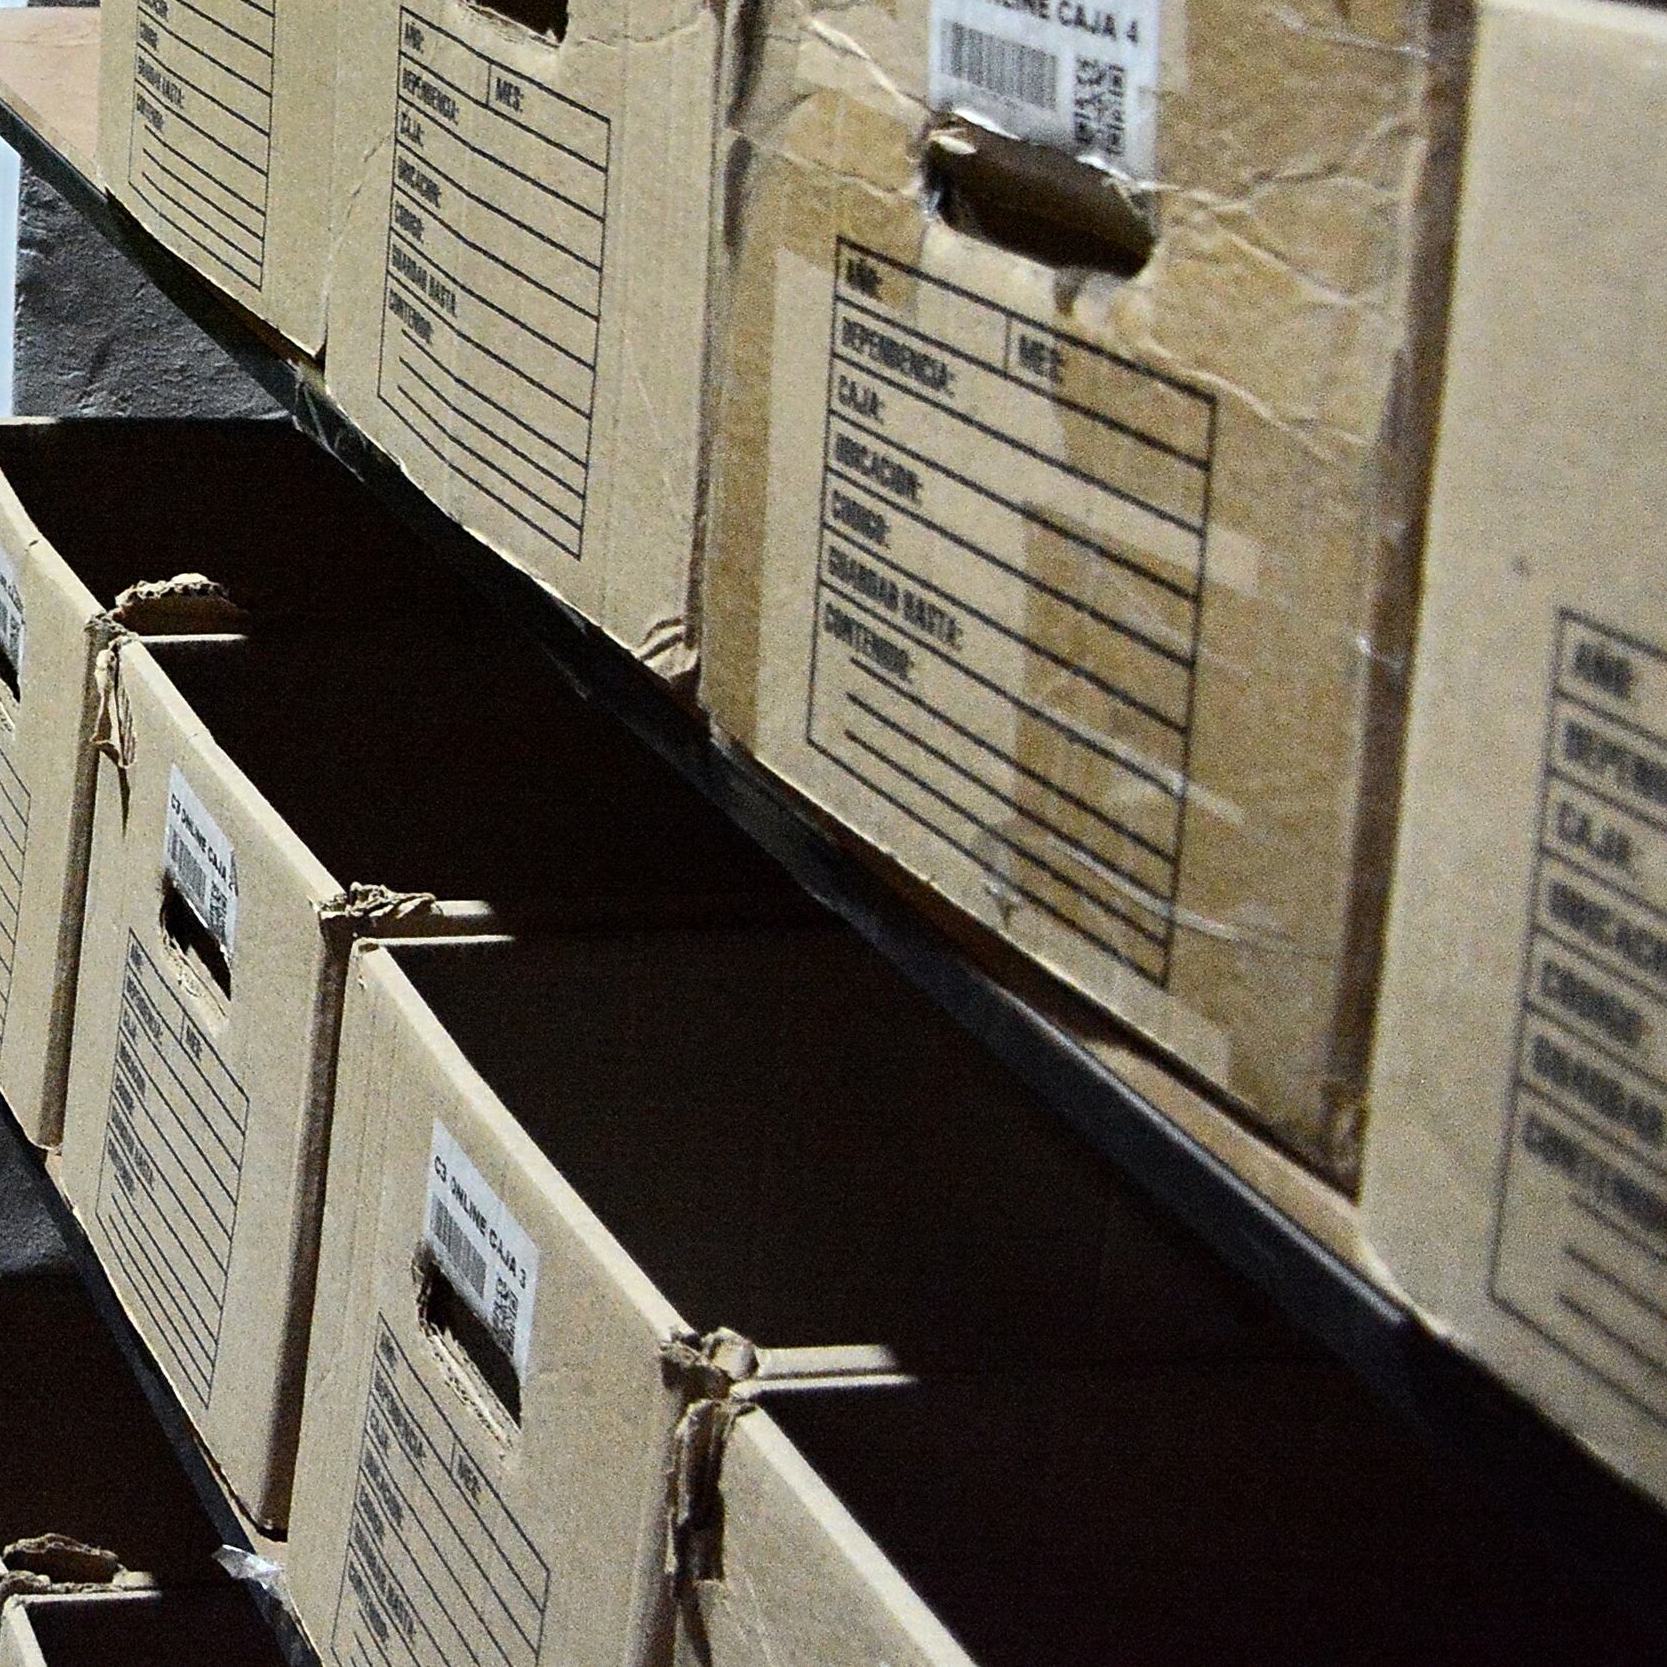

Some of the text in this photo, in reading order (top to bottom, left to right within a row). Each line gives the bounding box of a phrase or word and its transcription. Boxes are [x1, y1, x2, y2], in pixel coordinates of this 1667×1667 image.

[1057, 0, 1117, 42] CAJA
[1125, 19, 1139, 45] 4
[495, 76, 525, 114] MES:
[838, 373, 886, 426] CAJA:
[903, 588, 964, 653] HASTA:
[181, 808, 208, 854] ONLINE
[208, 845, 227, 883] CAJA
[450, 1175, 487, 1237] ONLINE
[488, 1227, 517, 1279] CAJA
